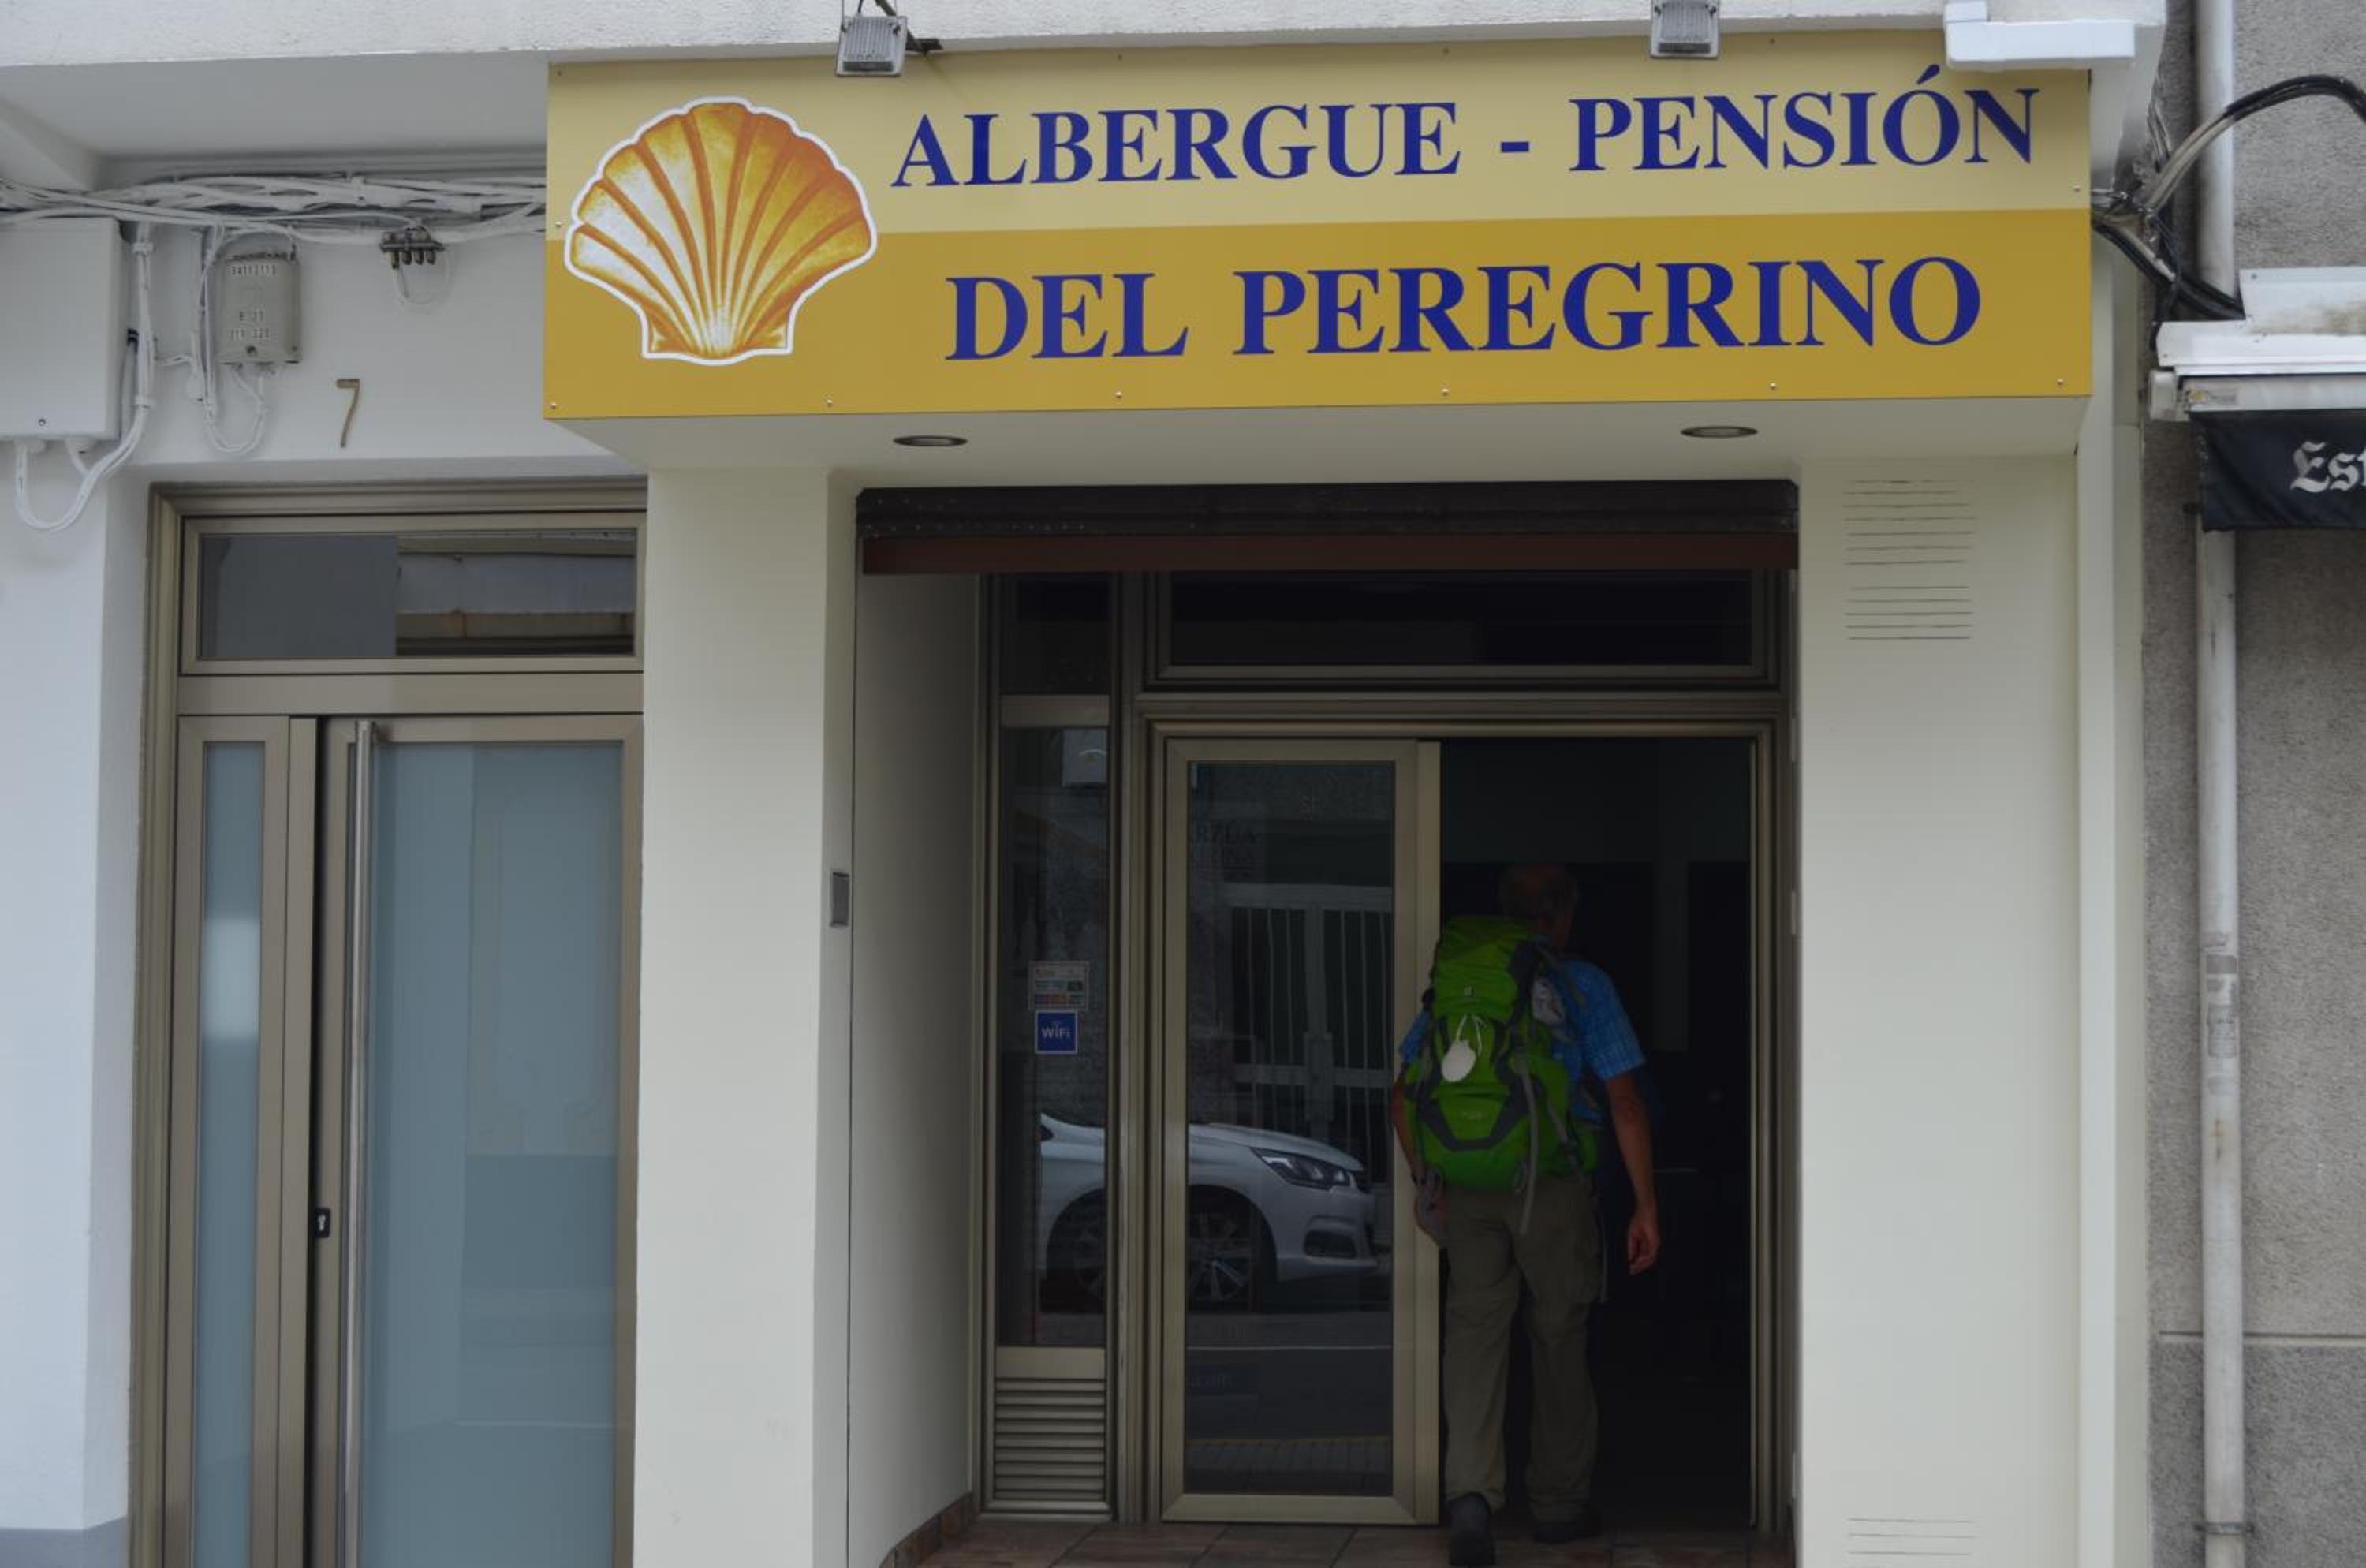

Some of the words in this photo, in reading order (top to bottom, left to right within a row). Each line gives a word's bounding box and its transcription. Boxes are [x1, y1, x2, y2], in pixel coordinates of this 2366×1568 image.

[891, 102, 1460, 187] ALBERGUE
[1500, 142, 1530, 152] -
[1569, 65, 2039, 171] PENSIÓN
[946, 272, 1189, 360] DEL
[1233, 257, 1981, 355] PEREGRINO
[336, 378, 360, 447] 7
